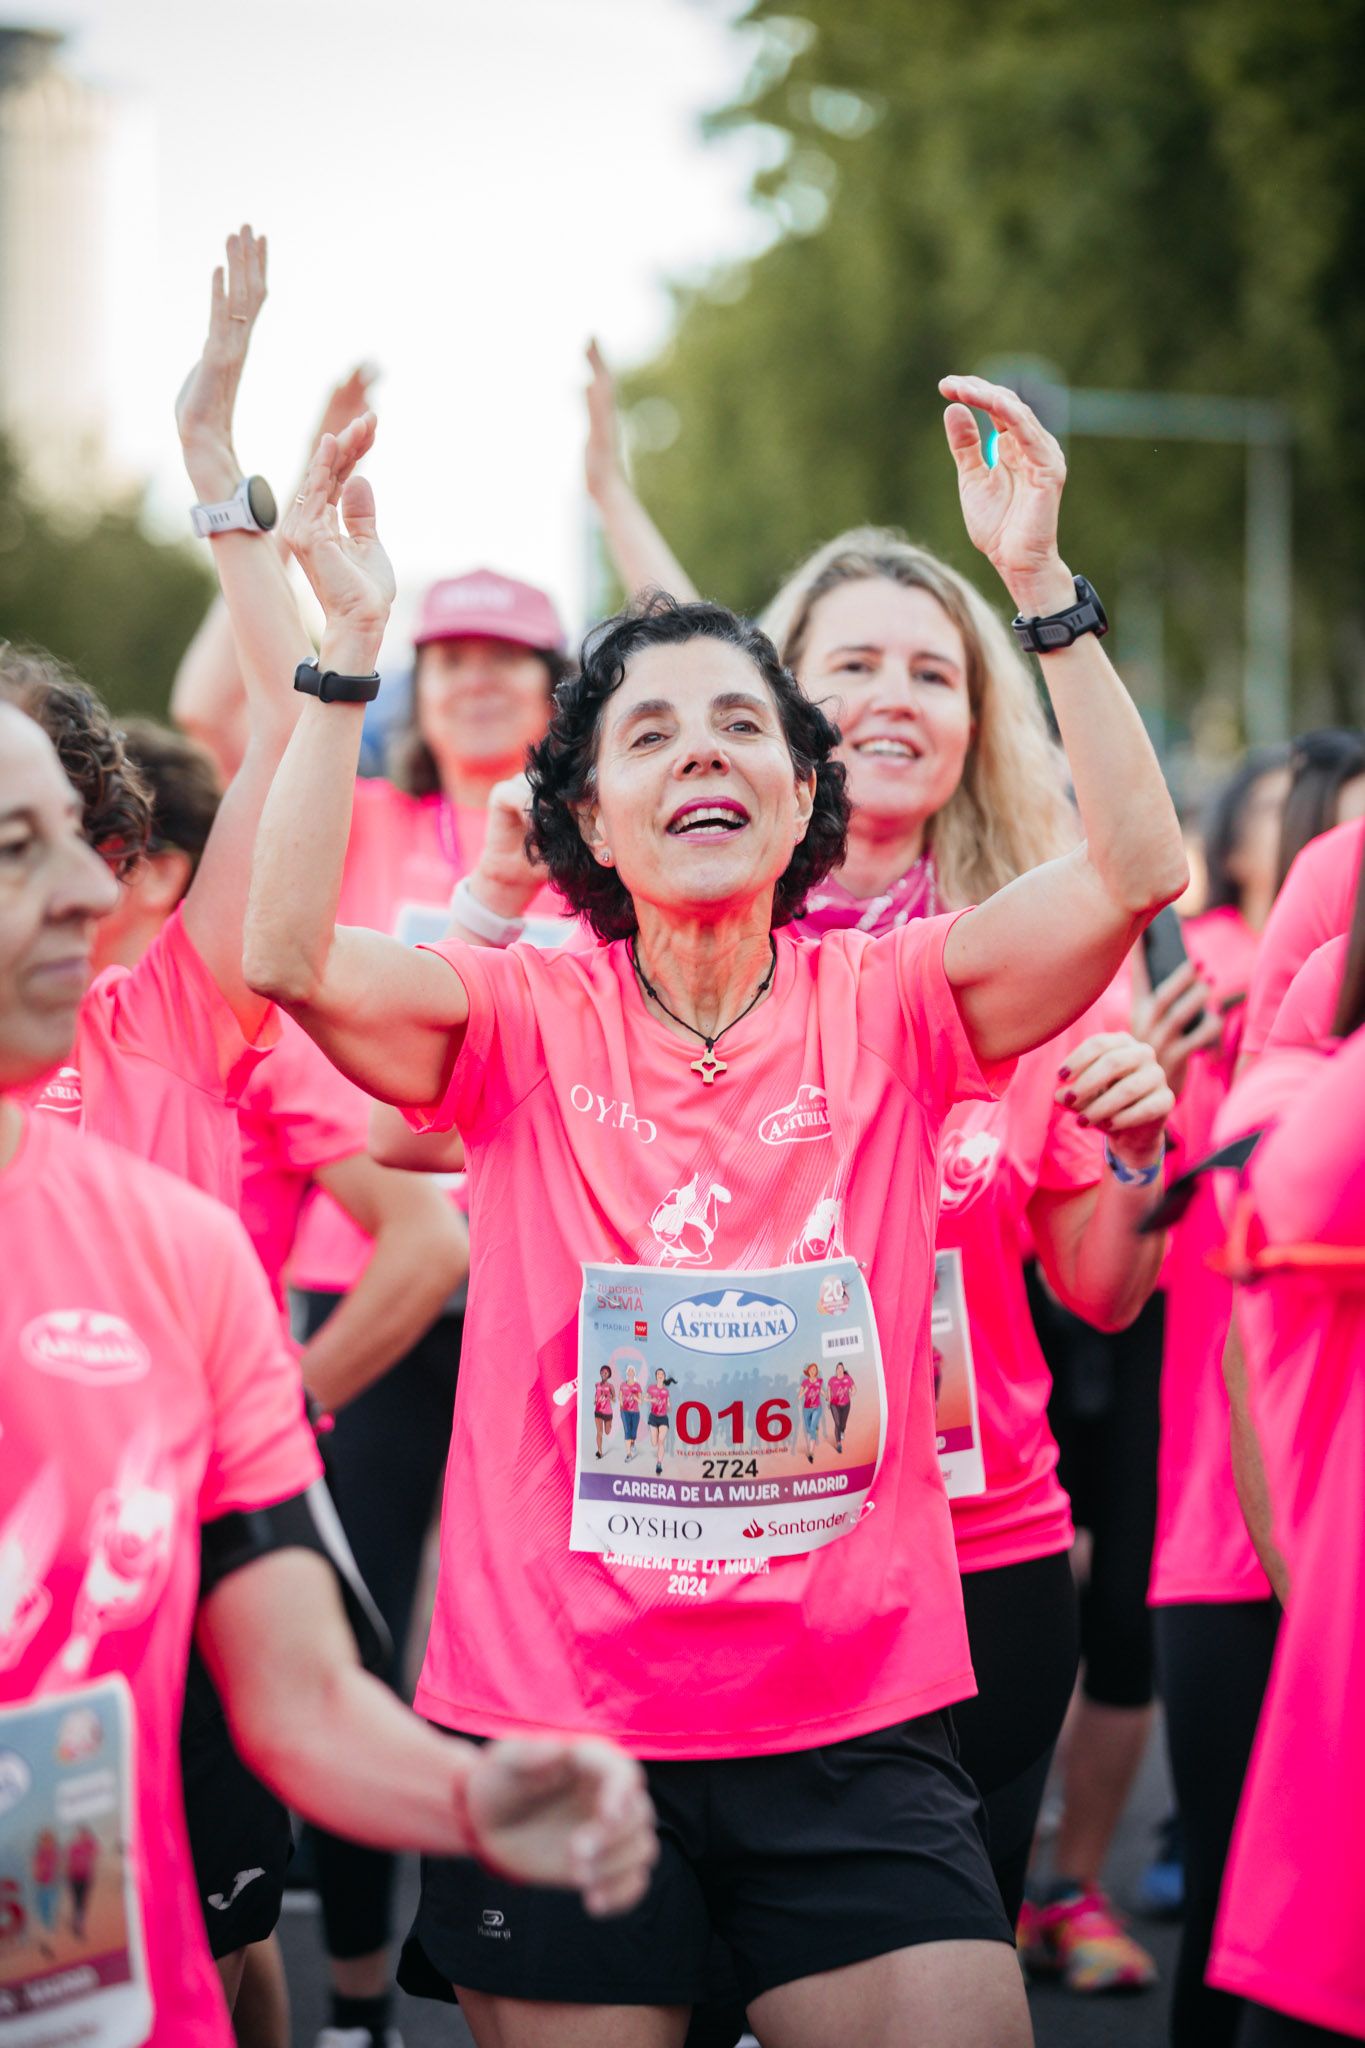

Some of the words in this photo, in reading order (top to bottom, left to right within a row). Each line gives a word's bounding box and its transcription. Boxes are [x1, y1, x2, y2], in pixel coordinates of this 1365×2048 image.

[570, 1084, 657, 1144] OYHO
[596, 1295, 643, 1312] SUMA
[608, 1286, 644, 1296] DORSAL
[602, 1323, 631, 1332] MADRID
[671, 1312, 789, 1339] ASTURIANA
[675, 1398, 792, 1445] 016
[702, 1458, 758, 1479] 2724
[612, 1479, 677, 1501] CARRERA
[680, 1485, 700, 1502] DE
[704, 1486, 724, 1502] LA
[728, 1483, 780, 1501] MUJER
[793, 1475, 849, 1497] MADRID
[607, 1513, 703, 1541] OYSHO
[767, 1511, 848, 1537] Santander
[667, 1574, 707, 1597] 2024
